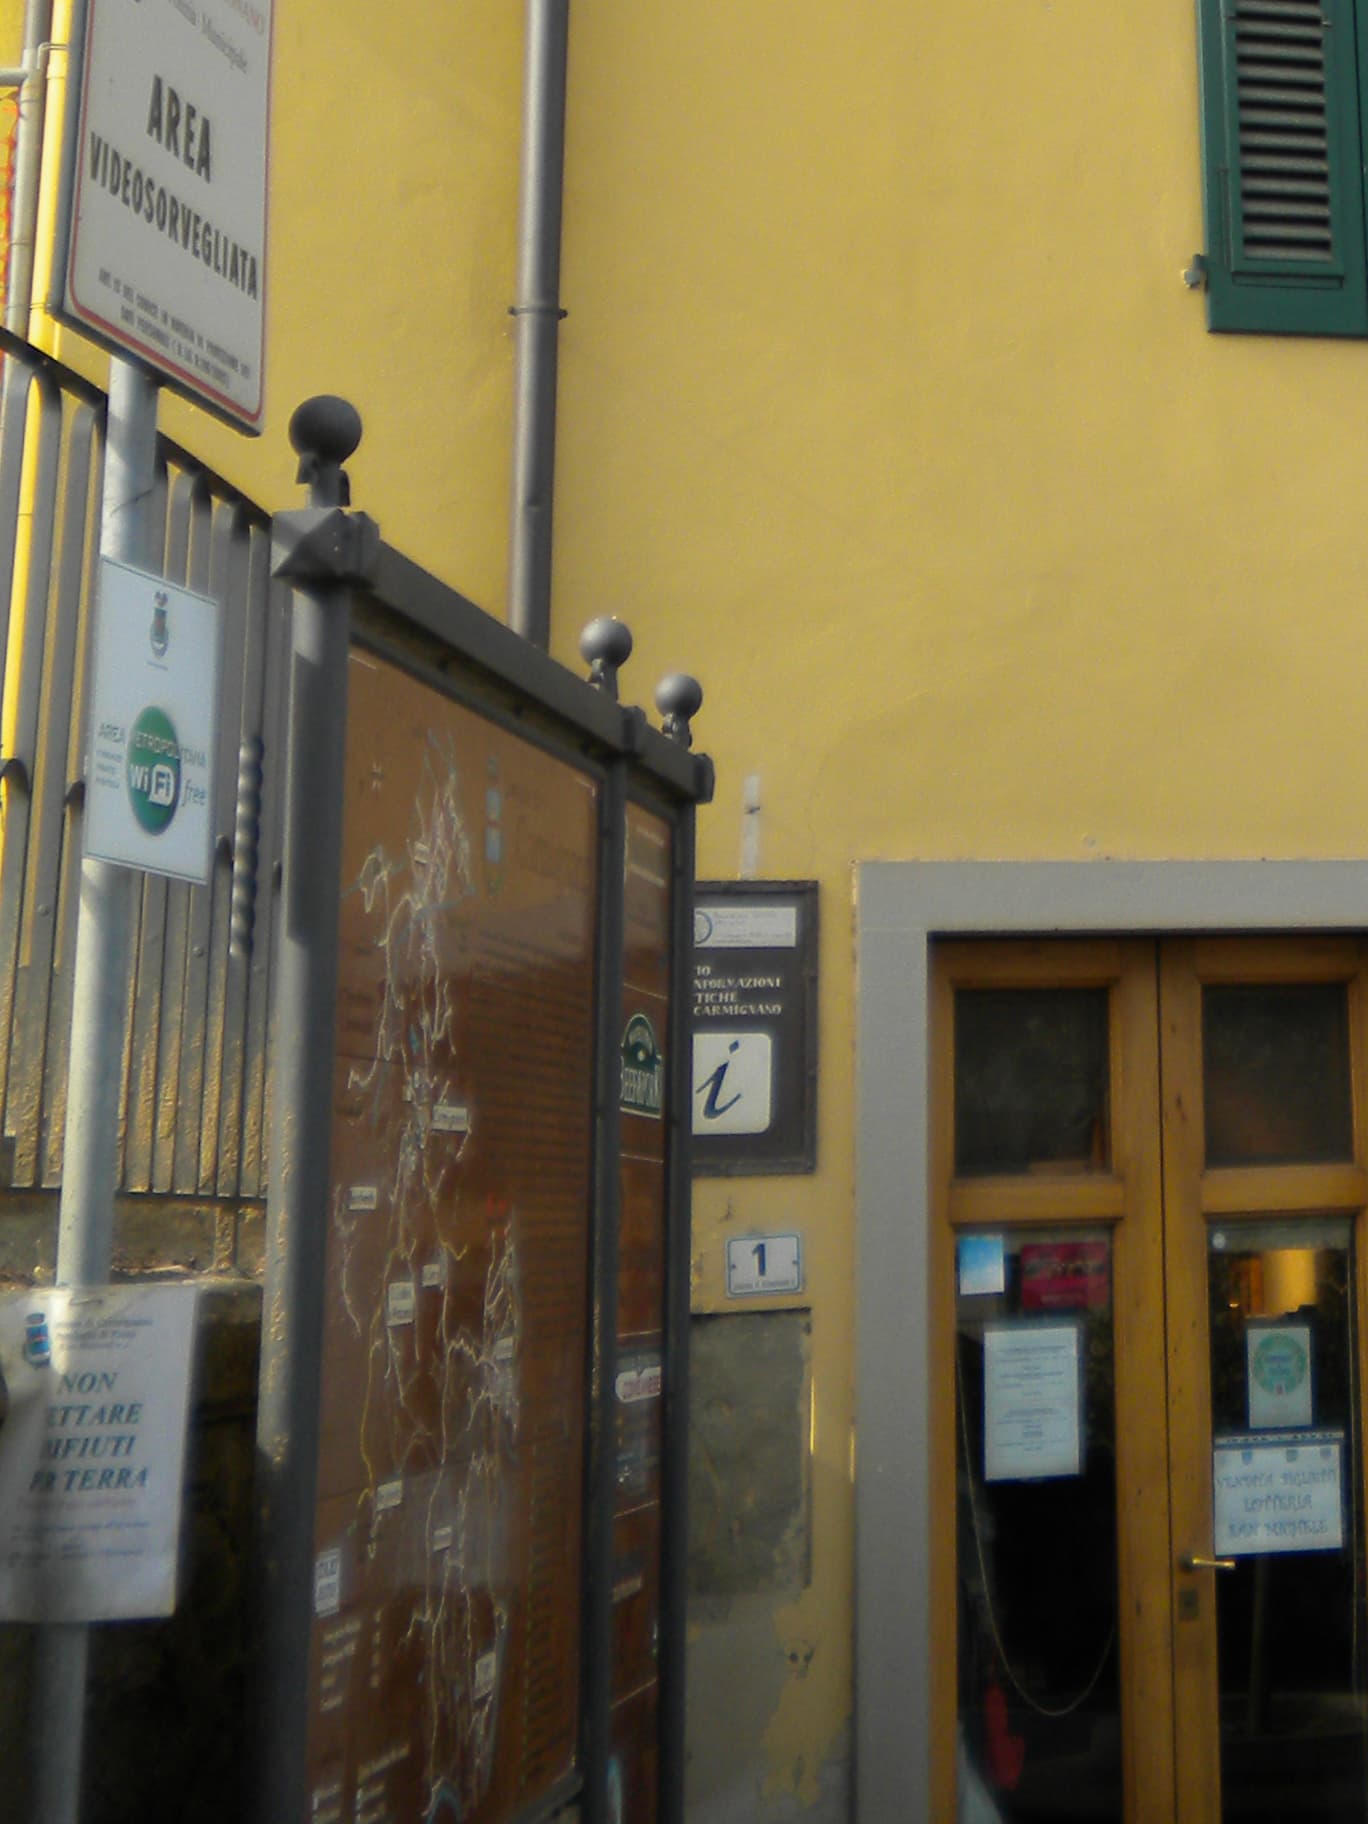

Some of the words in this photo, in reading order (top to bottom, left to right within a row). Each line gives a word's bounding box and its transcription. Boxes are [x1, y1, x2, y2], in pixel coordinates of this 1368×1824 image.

[147, 74, 210, 183] AREA
[90, 131, 257, 300] VIDEOSORVEGLIATA
[181, 778, 207, 807] free
[692, 1003, 783, 1018] CARMIGNANO
[752, 1243, 767, 1277] 1
[57, 1372, 118, 1395] NON
[47, 1402, 144, 1426] ETTARE
[44, 1434, 137, 1459] IFIUTI
[63, 1466, 149, 1492] TERRA
